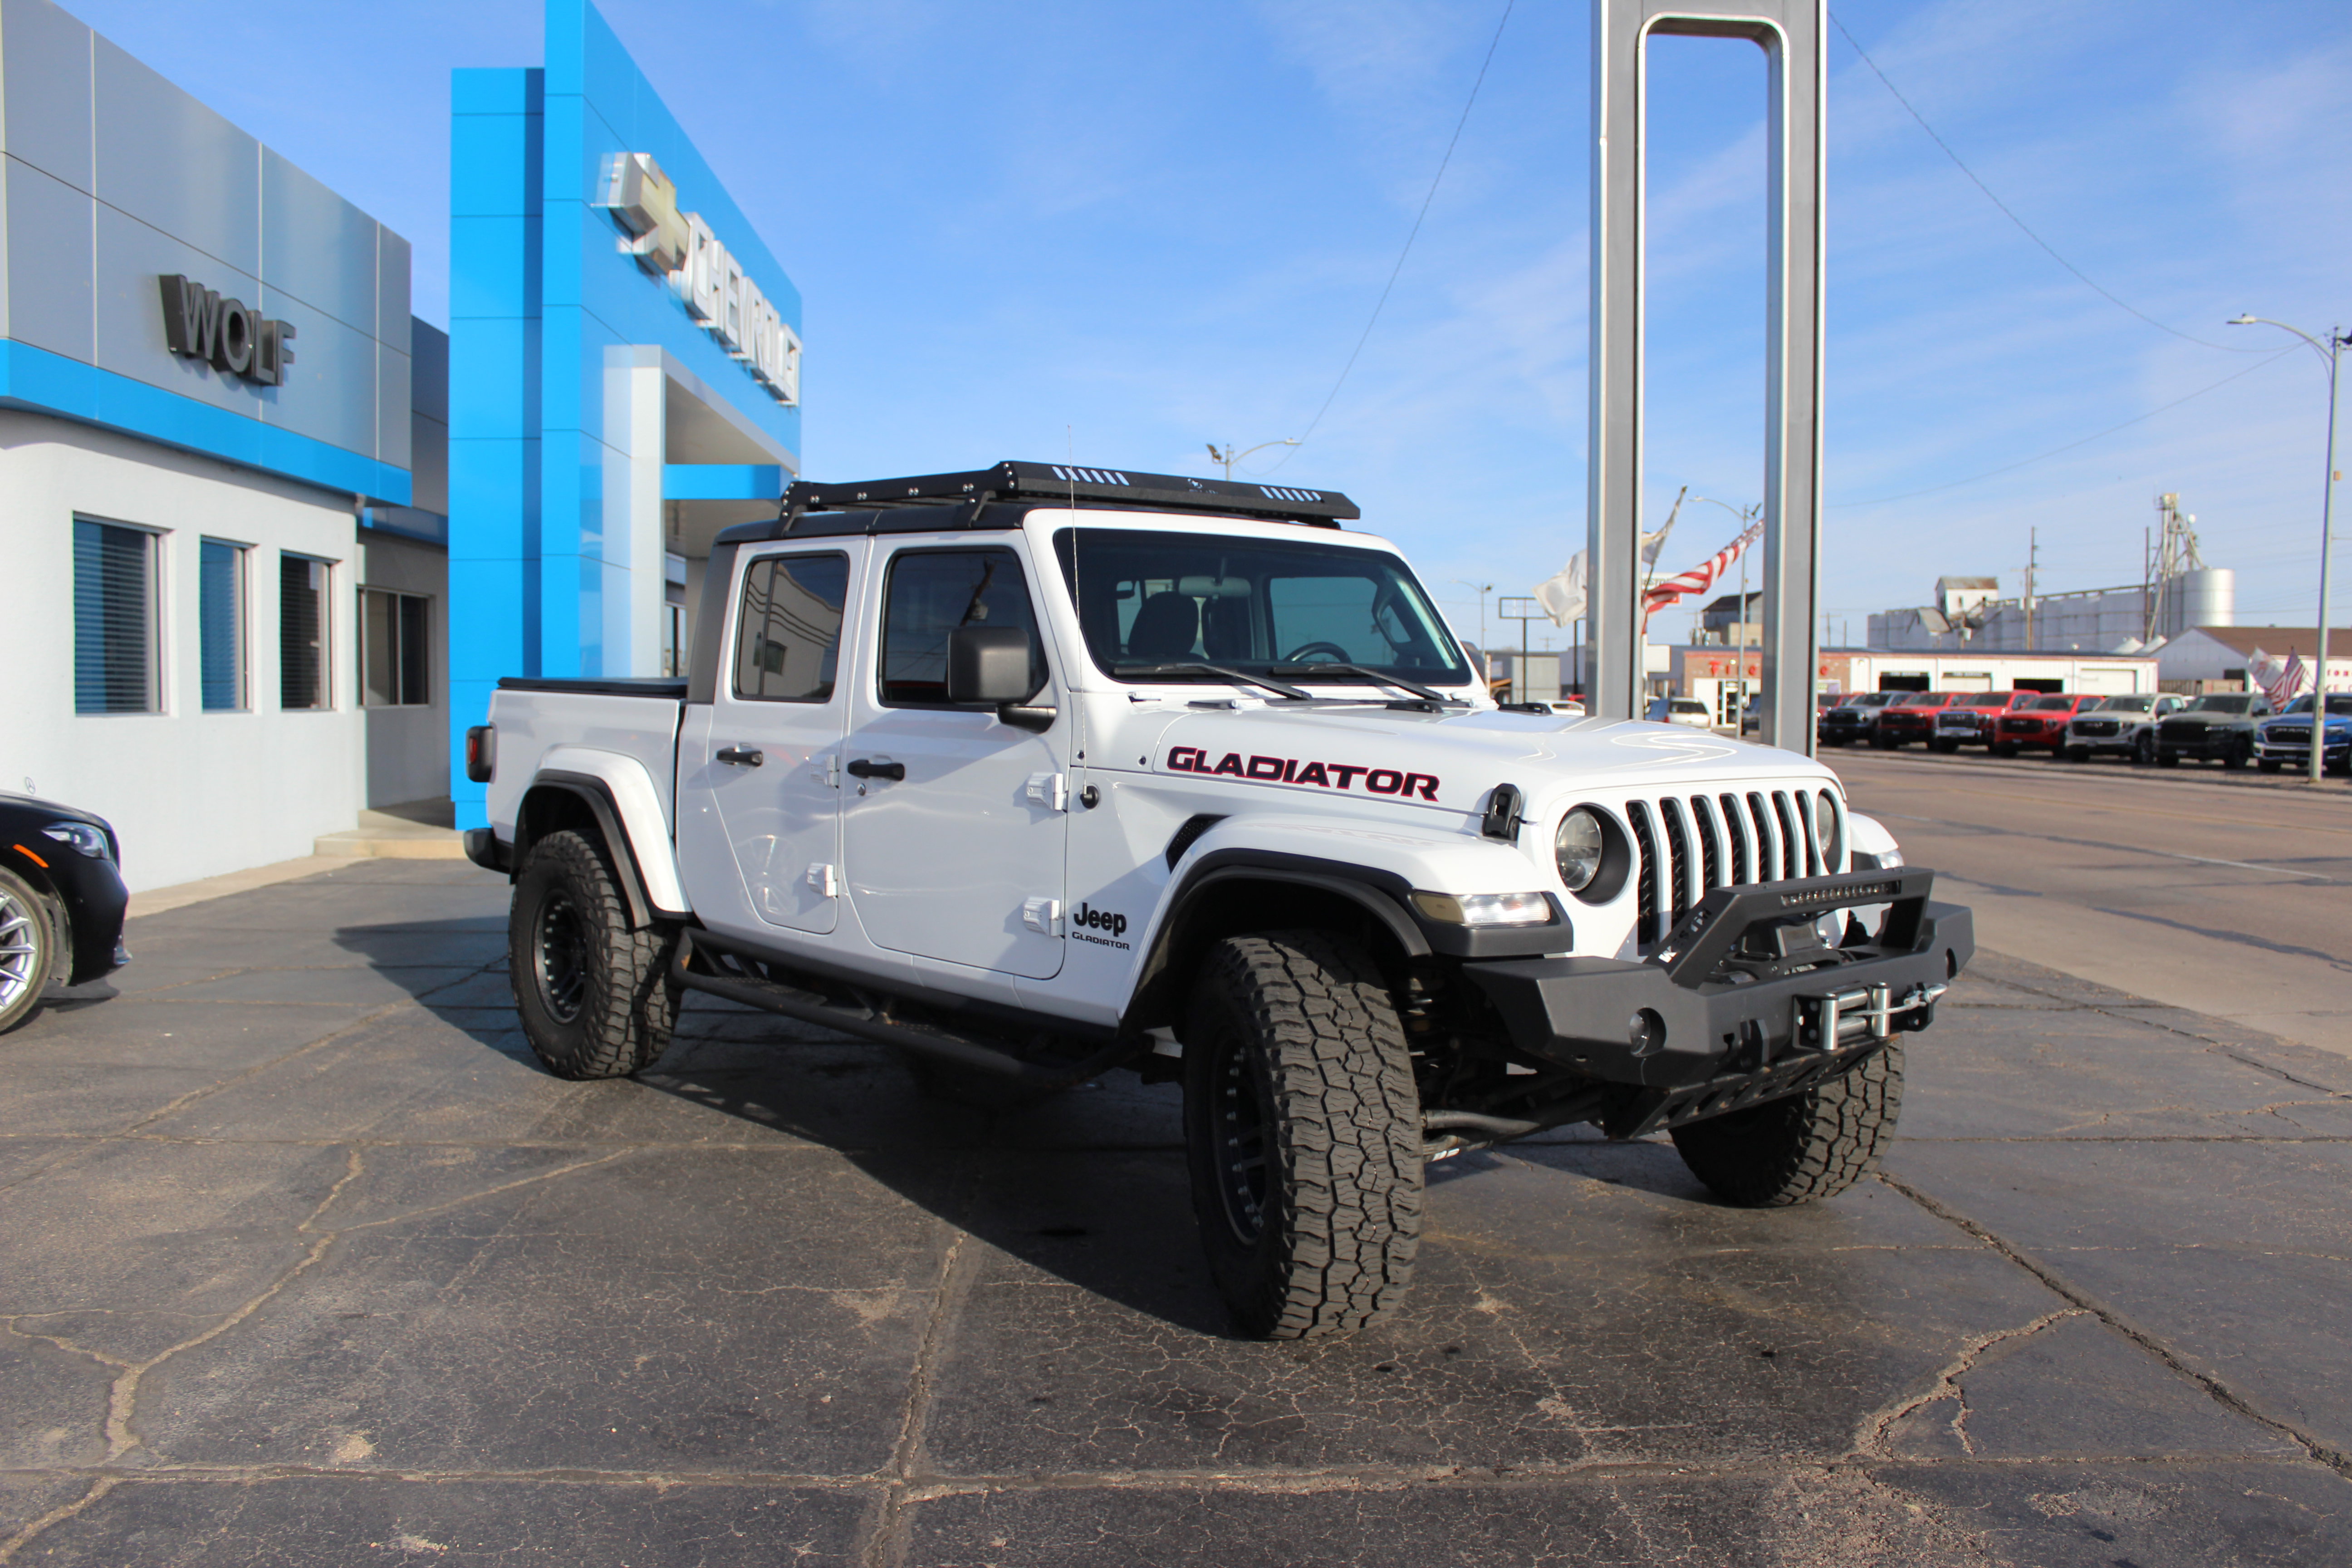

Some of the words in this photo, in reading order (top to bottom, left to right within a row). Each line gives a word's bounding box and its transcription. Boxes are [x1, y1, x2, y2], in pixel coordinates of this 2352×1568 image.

[159, 274, 296, 387] WOLF
[671, 211, 802, 407] CHEVROLET
[1166, 746, 1440, 802] GLADIATOR
[1072, 931, 1130, 951] GLADIATOR
[1073, 902, 1127, 937] Jeep
